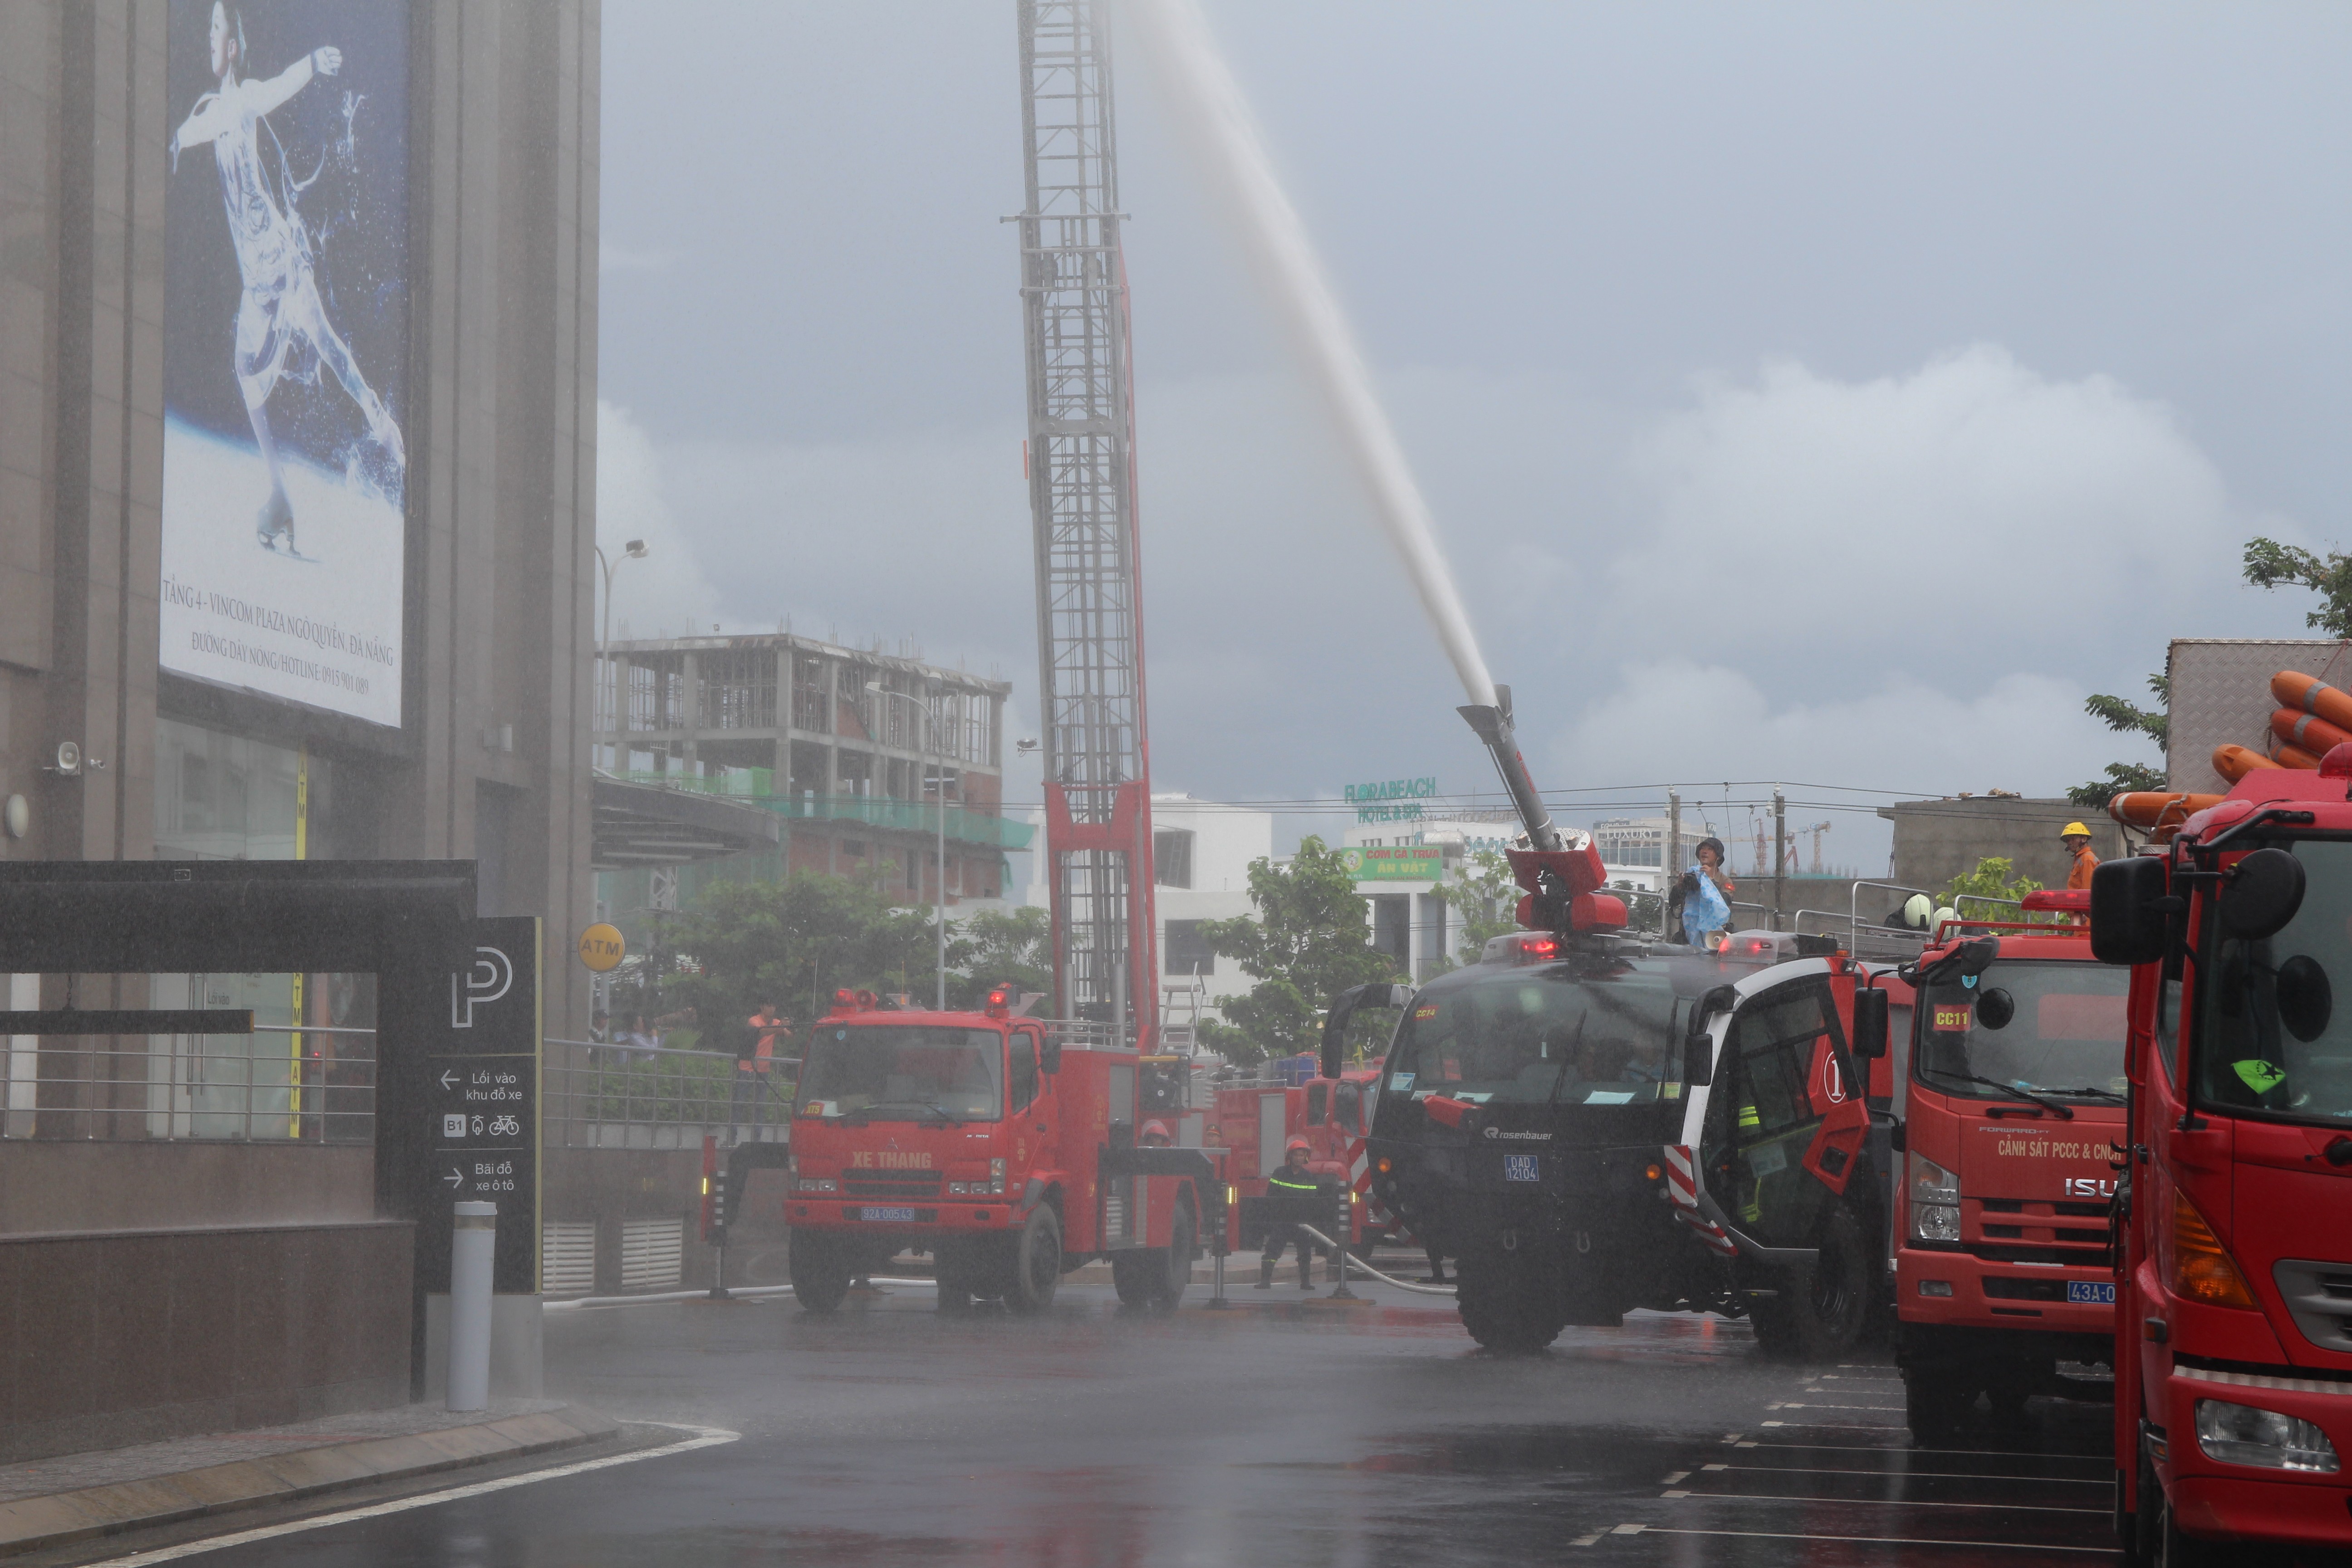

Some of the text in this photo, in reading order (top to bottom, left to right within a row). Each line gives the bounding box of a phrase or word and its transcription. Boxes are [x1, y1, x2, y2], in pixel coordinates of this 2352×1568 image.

[196, 591, 201, 610] 4
[210, 593, 253, 624] VINCOM
[256, 607, 285, 633] PLAZA
[350, 632, 363, 657] ĐÀ
[323, 666, 339, 686] 0915
[342, 672, 353, 691] 901
[356, 677, 368, 695] 089
[1607, 828, 1655, 839] LUXURY
[581, 939, 620, 956] ATM
[1416, 1009, 1436, 1017] CC14
[1936, 1012, 1967, 1025] CC11
[472, 1070, 516, 1084] Lối vào
[466, 1087, 522, 1100] khu đỗ xe
[447, 1120, 462, 1131] B1
[1499, 1130, 1552, 1140] rosenbauer
[1998, 1135, 2026, 1156] CẢNH
[2029, 1137, 2049, 1157] SÁT
[2053, 1142, 2079, 1159] PCCC
[2082, 1143, 2090, 1159] &
[853, 1152, 931, 1168] XE THANG
[1511, 1157, 1530, 1168] DAD
[475, 1161, 512, 1174] Bãi đỗ
[1508, 1168, 1536, 1179] 12104
[476, 1179, 514, 1190] xe ô tô
